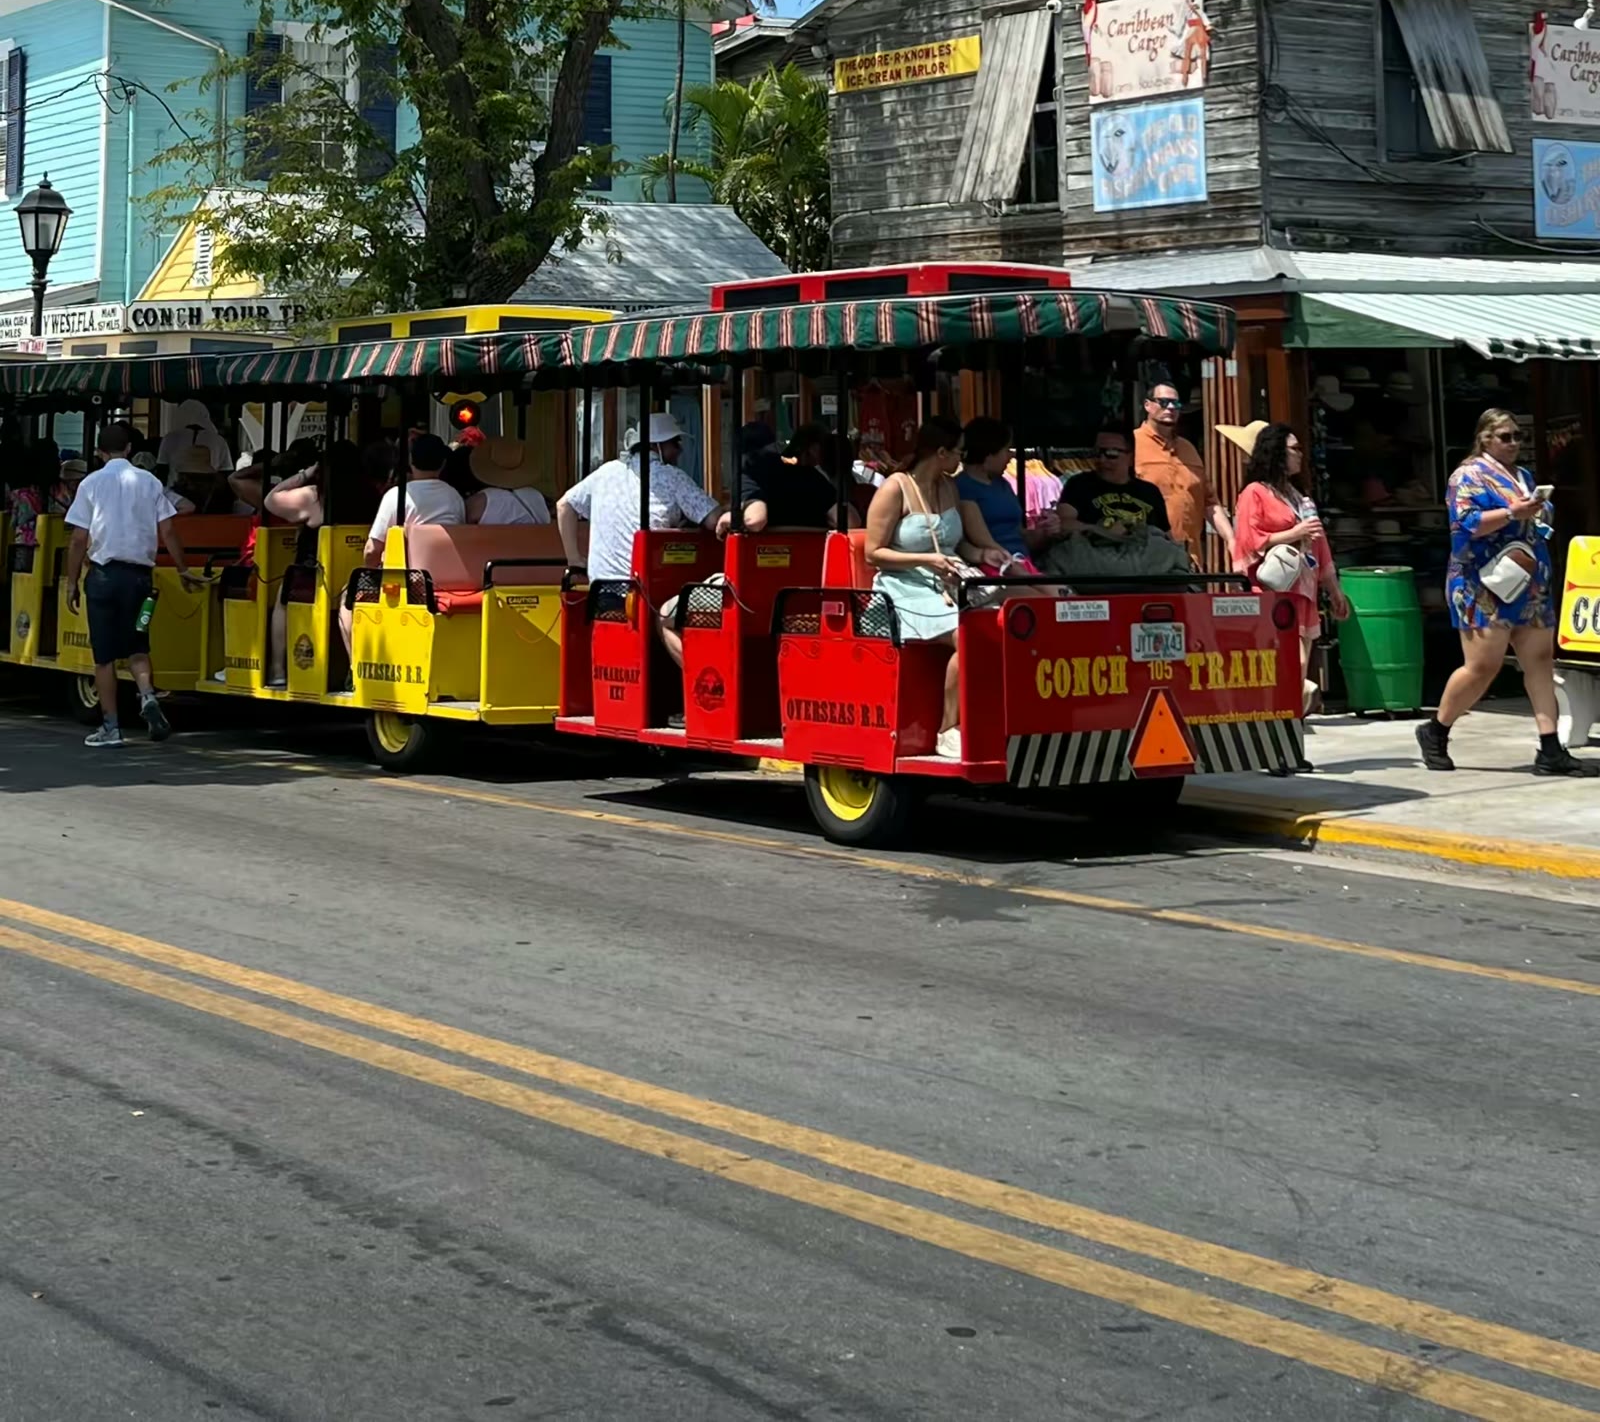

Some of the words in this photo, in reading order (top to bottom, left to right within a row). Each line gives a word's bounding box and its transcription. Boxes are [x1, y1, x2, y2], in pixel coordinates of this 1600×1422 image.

[1107, 8, 1175, 38] Caribbean
[1128, 34, 1168, 62] Cargo
[1570, 63, 1600, 94] Carg
[14, 316, 28, 326] CUBA
[132, 306, 202, 328] CONCH
[5, 328, 22, 338] MILES
[357, 661, 402, 683] OVERSEAS
[405, 664, 425, 684] R.R.
[1036, 655, 1129, 699] CONCH
[1147, 661, 1173, 680] 105
[1185, 649, 1278, 690] TRAIN
[786, 697, 856, 726] OVERSEAS
[861, 703, 891, 729] R.R.
[1184, 709, 1295, 726] www.conchtourtrain.com
